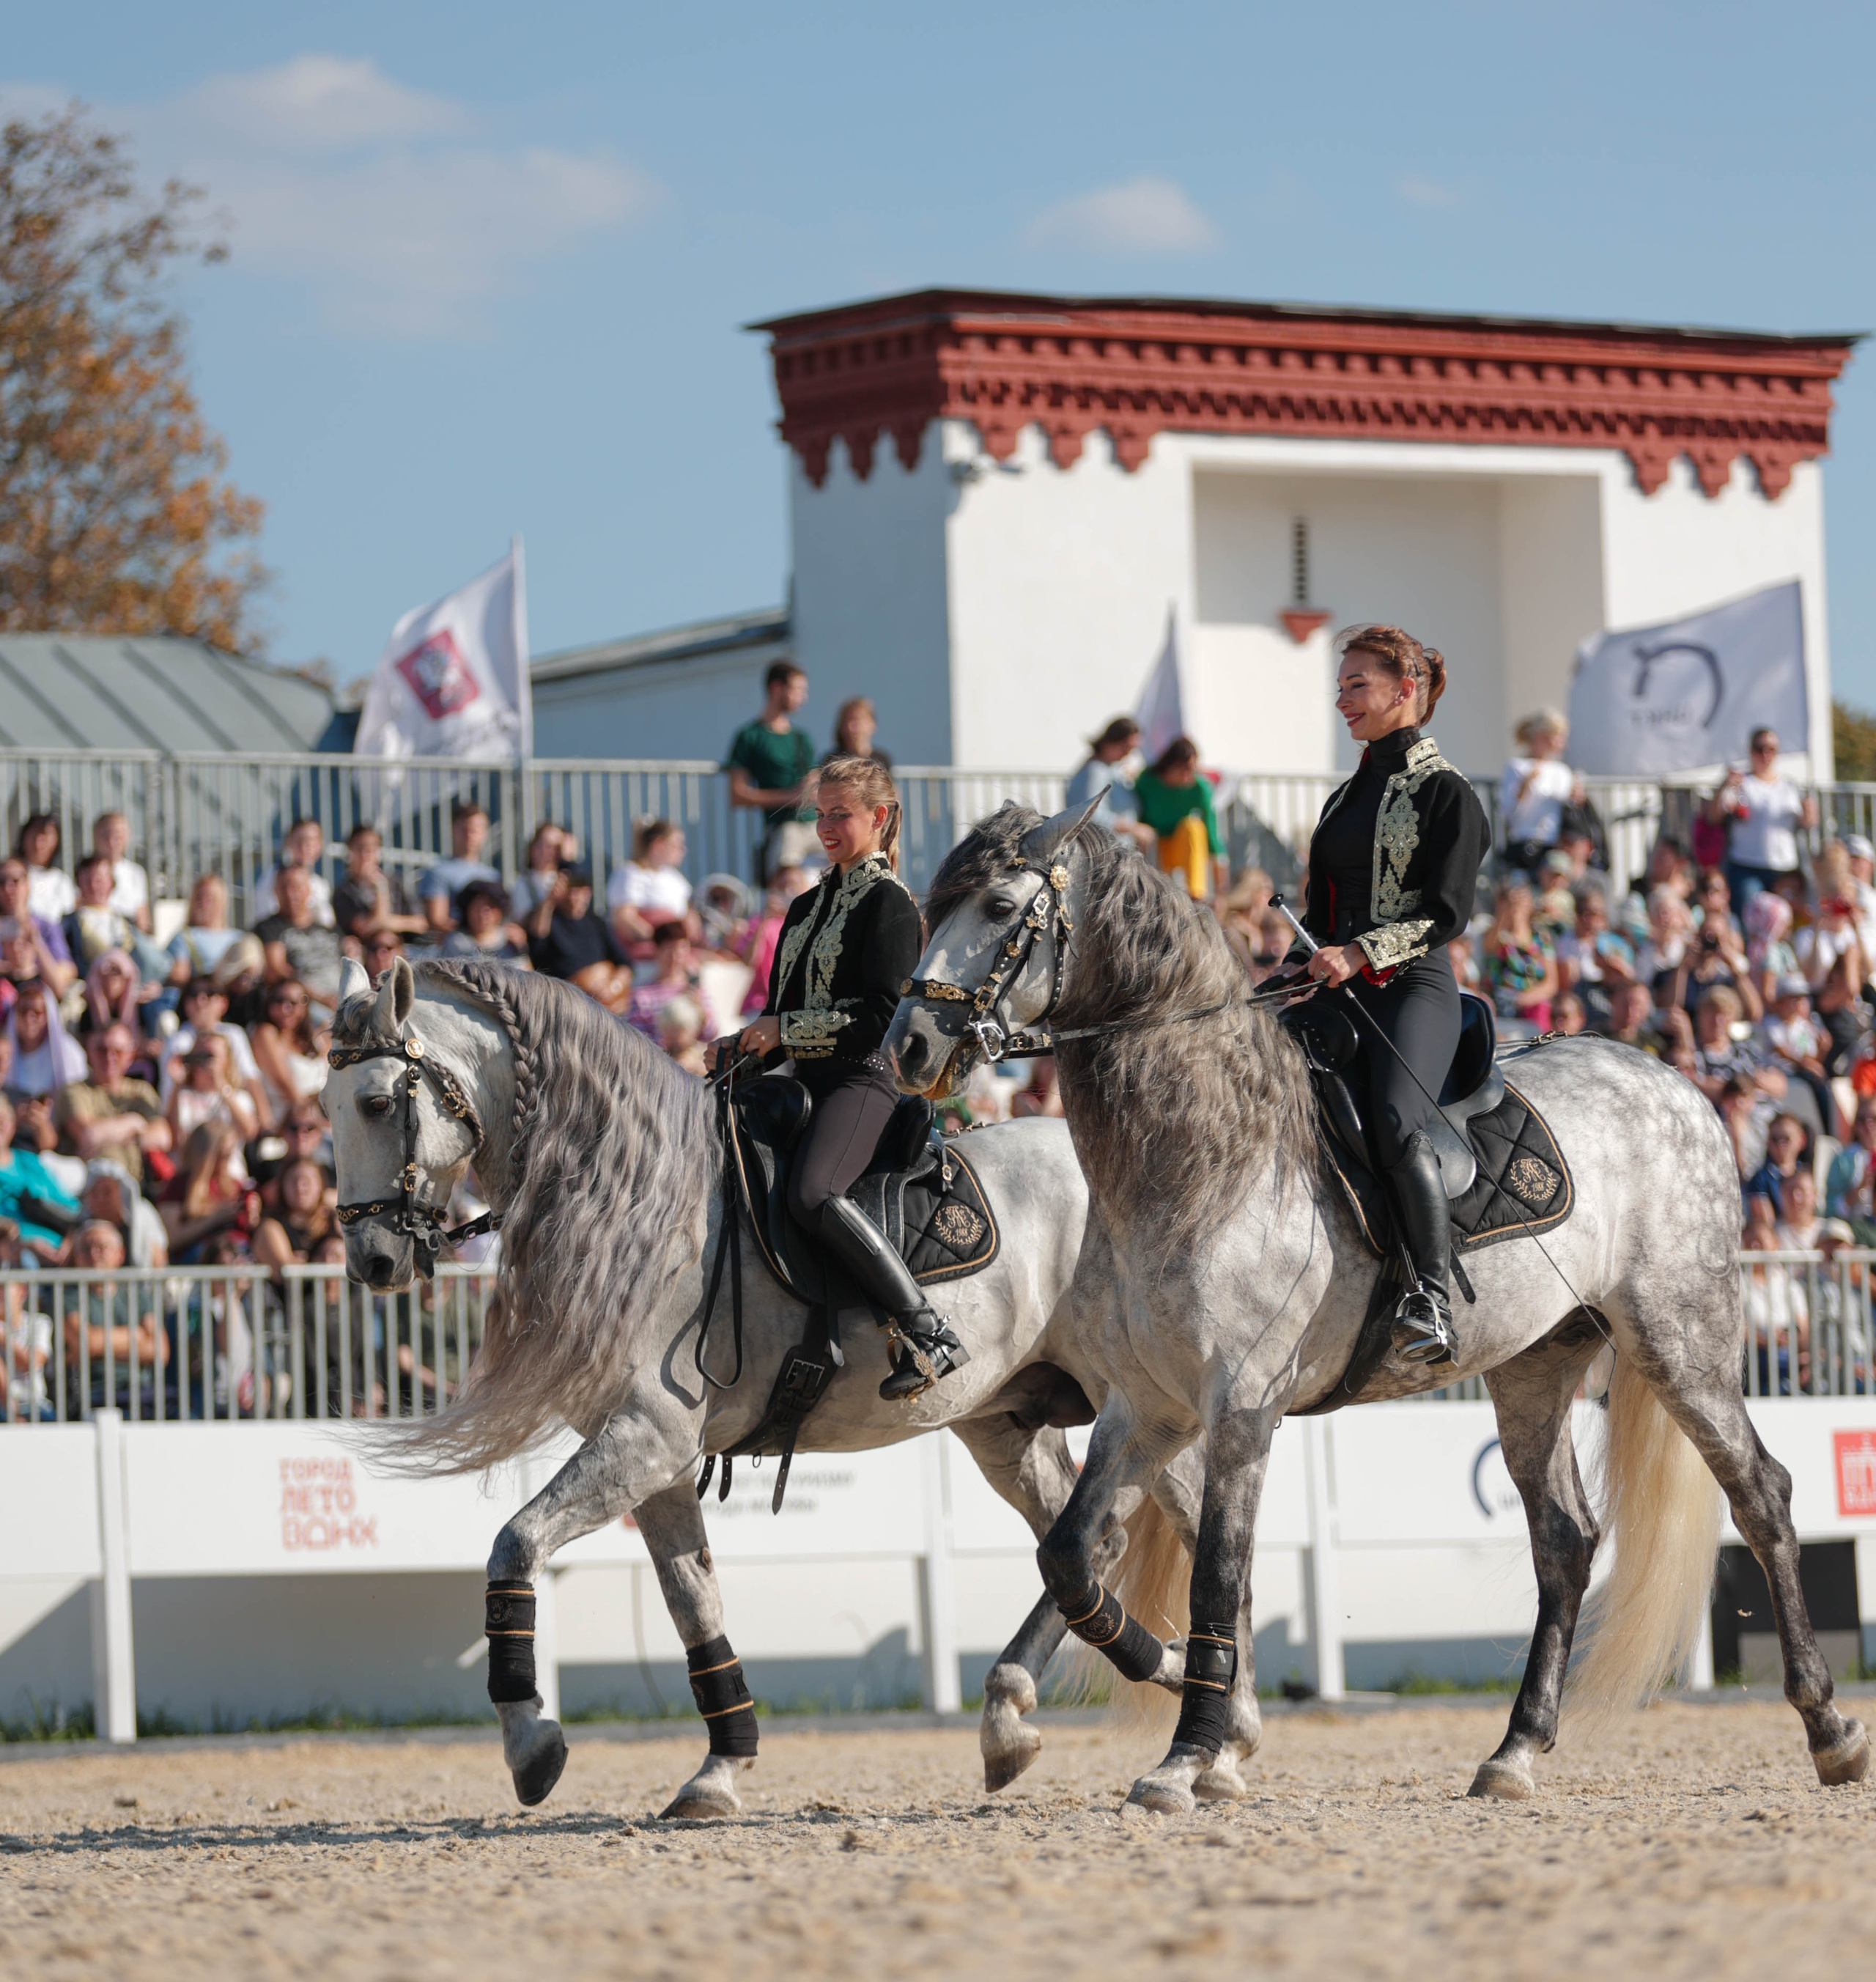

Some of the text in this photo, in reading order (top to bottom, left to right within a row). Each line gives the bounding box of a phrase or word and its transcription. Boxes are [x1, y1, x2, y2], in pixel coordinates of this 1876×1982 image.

[279, 1457, 353, 1482] ГОРОД
[281, 1485, 356, 1514] ЛЕТО
[282, 1515, 379, 1550] ВДНХ
